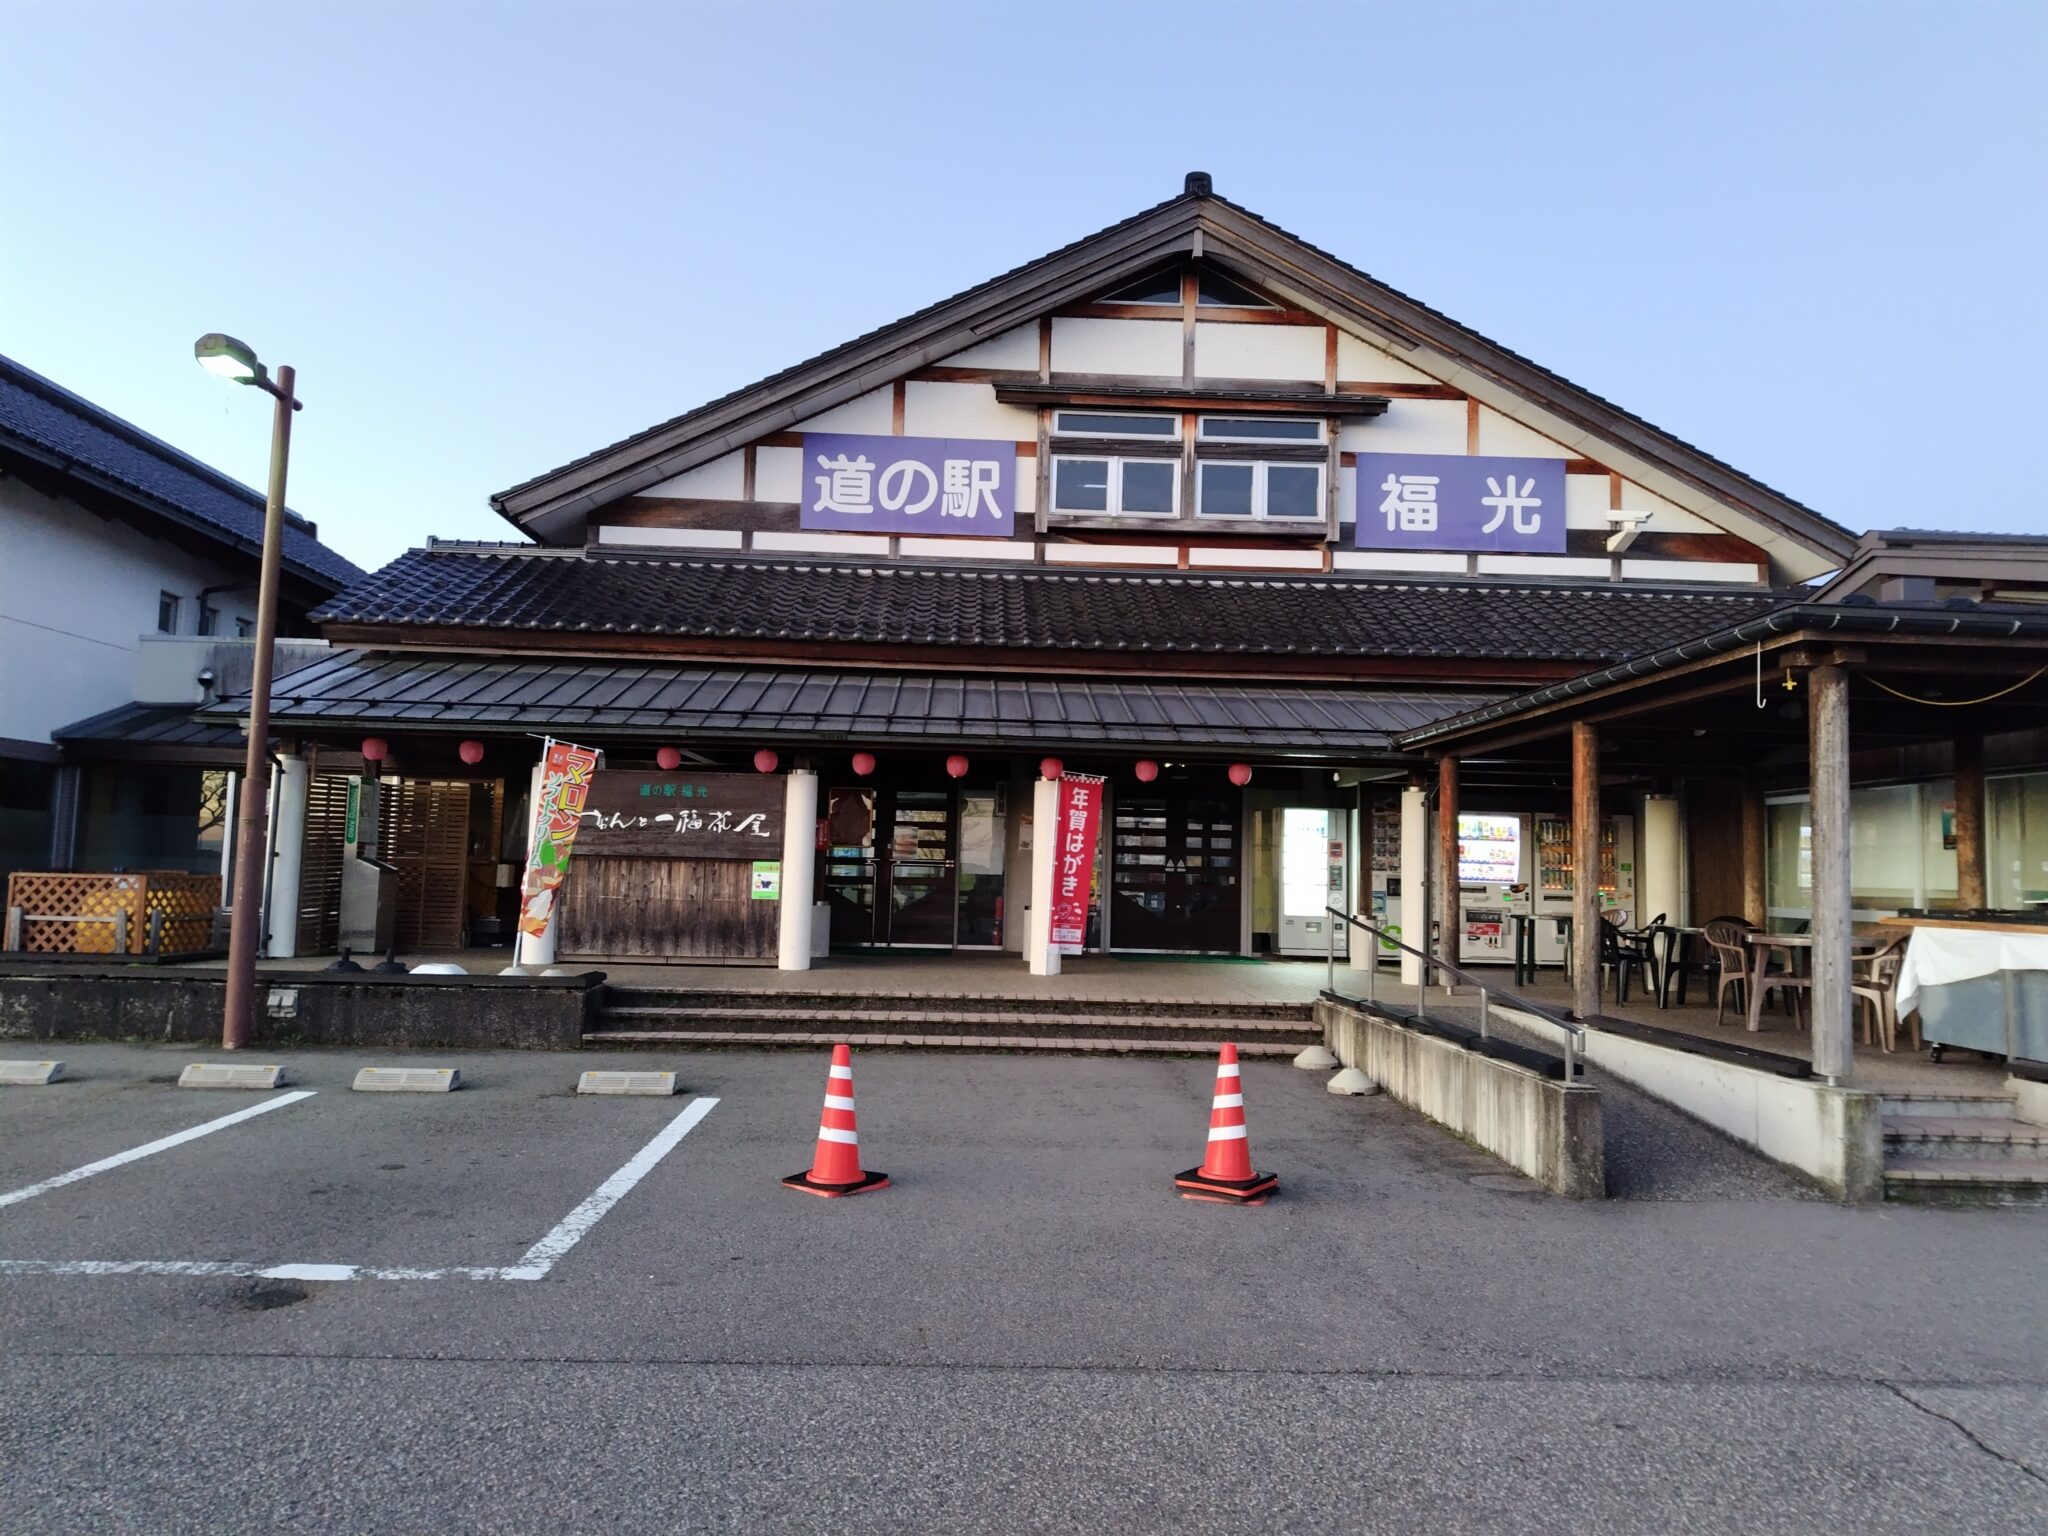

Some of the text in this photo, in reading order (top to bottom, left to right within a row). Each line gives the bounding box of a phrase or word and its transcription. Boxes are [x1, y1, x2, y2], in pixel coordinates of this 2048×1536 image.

[813, 453, 1003, 519] 道の駅
[1379, 473, 1542, 534] 福光
[530, 771, 563, 868] ソフトクリーム
[550, 752, 596, 842] マロン
[639, 783, 709, 798] 道の駅 福光
[1061, 787, 1090, 898] 年賀はがき
